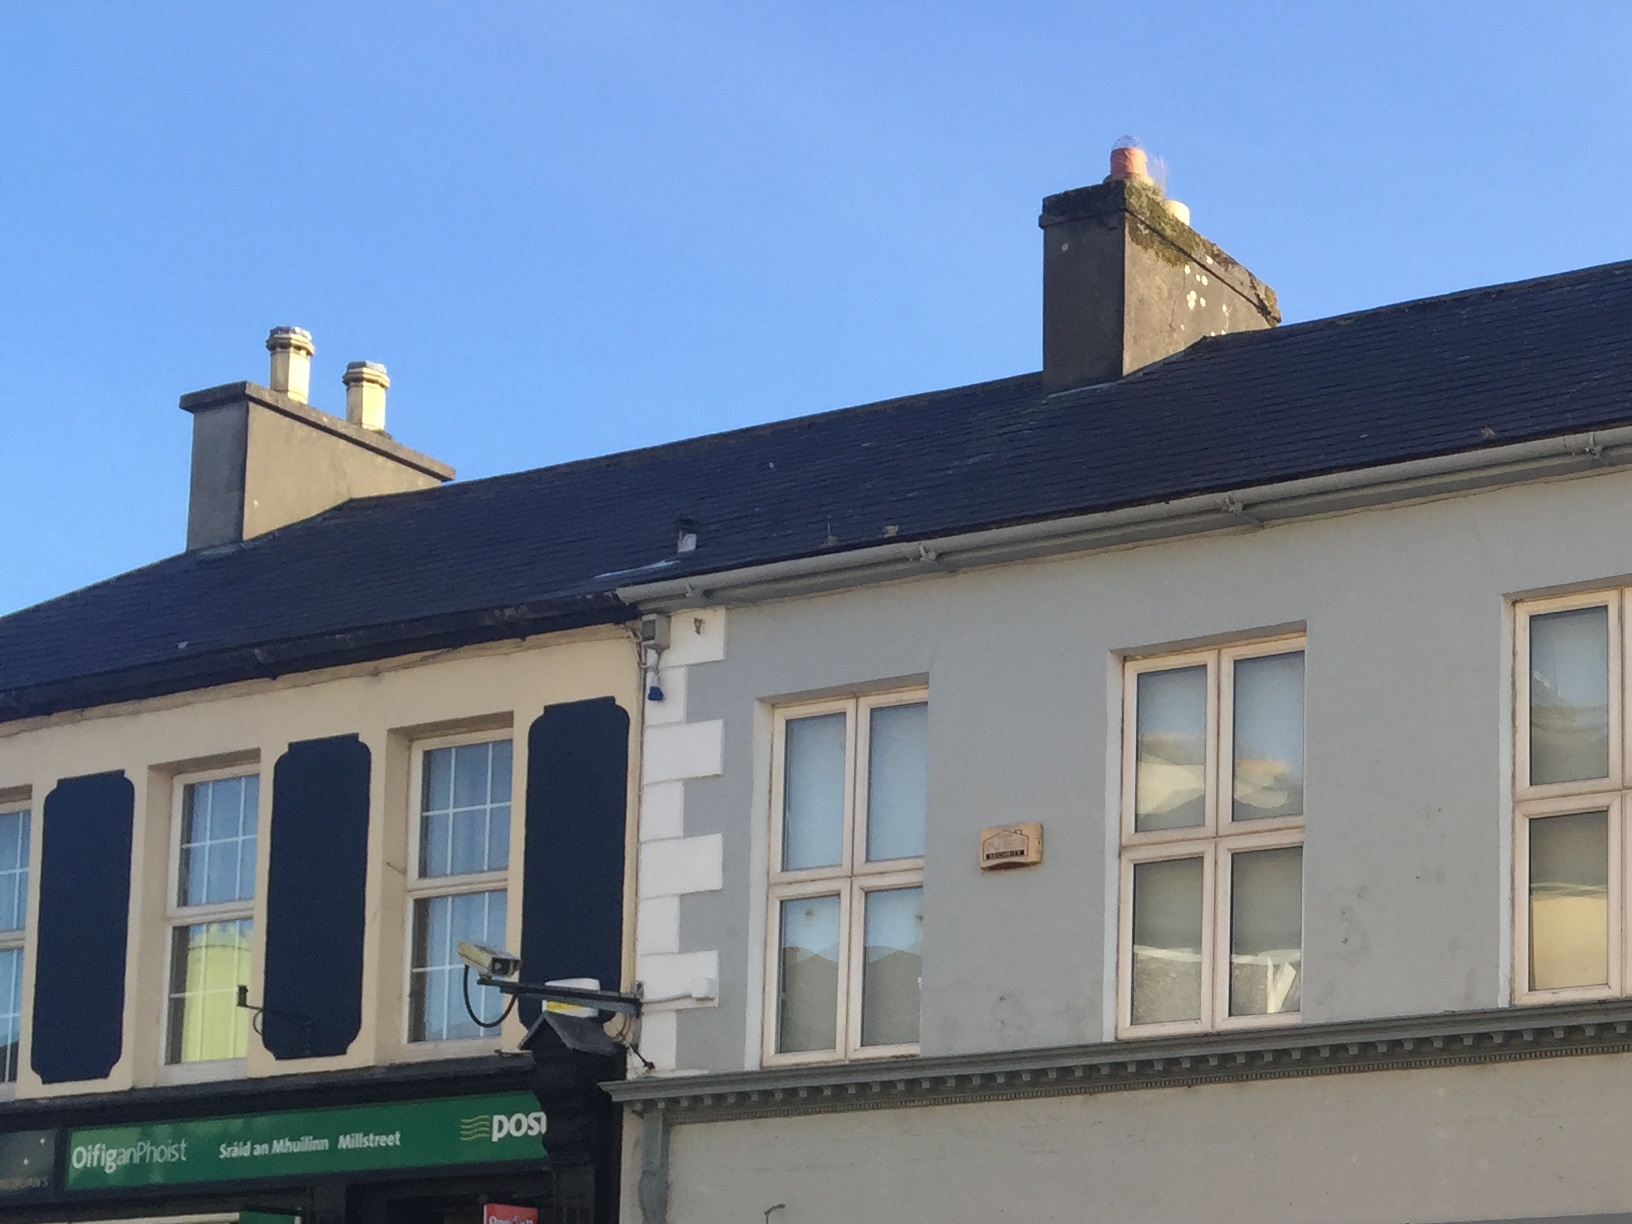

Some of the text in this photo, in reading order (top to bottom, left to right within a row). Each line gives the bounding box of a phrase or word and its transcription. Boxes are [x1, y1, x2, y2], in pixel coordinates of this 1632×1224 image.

[253, 1144, 269, 1155] an
[271, 1136, 330, 1154] Mhuilinn
[337, 1130, 401, 1150] Millstreet
